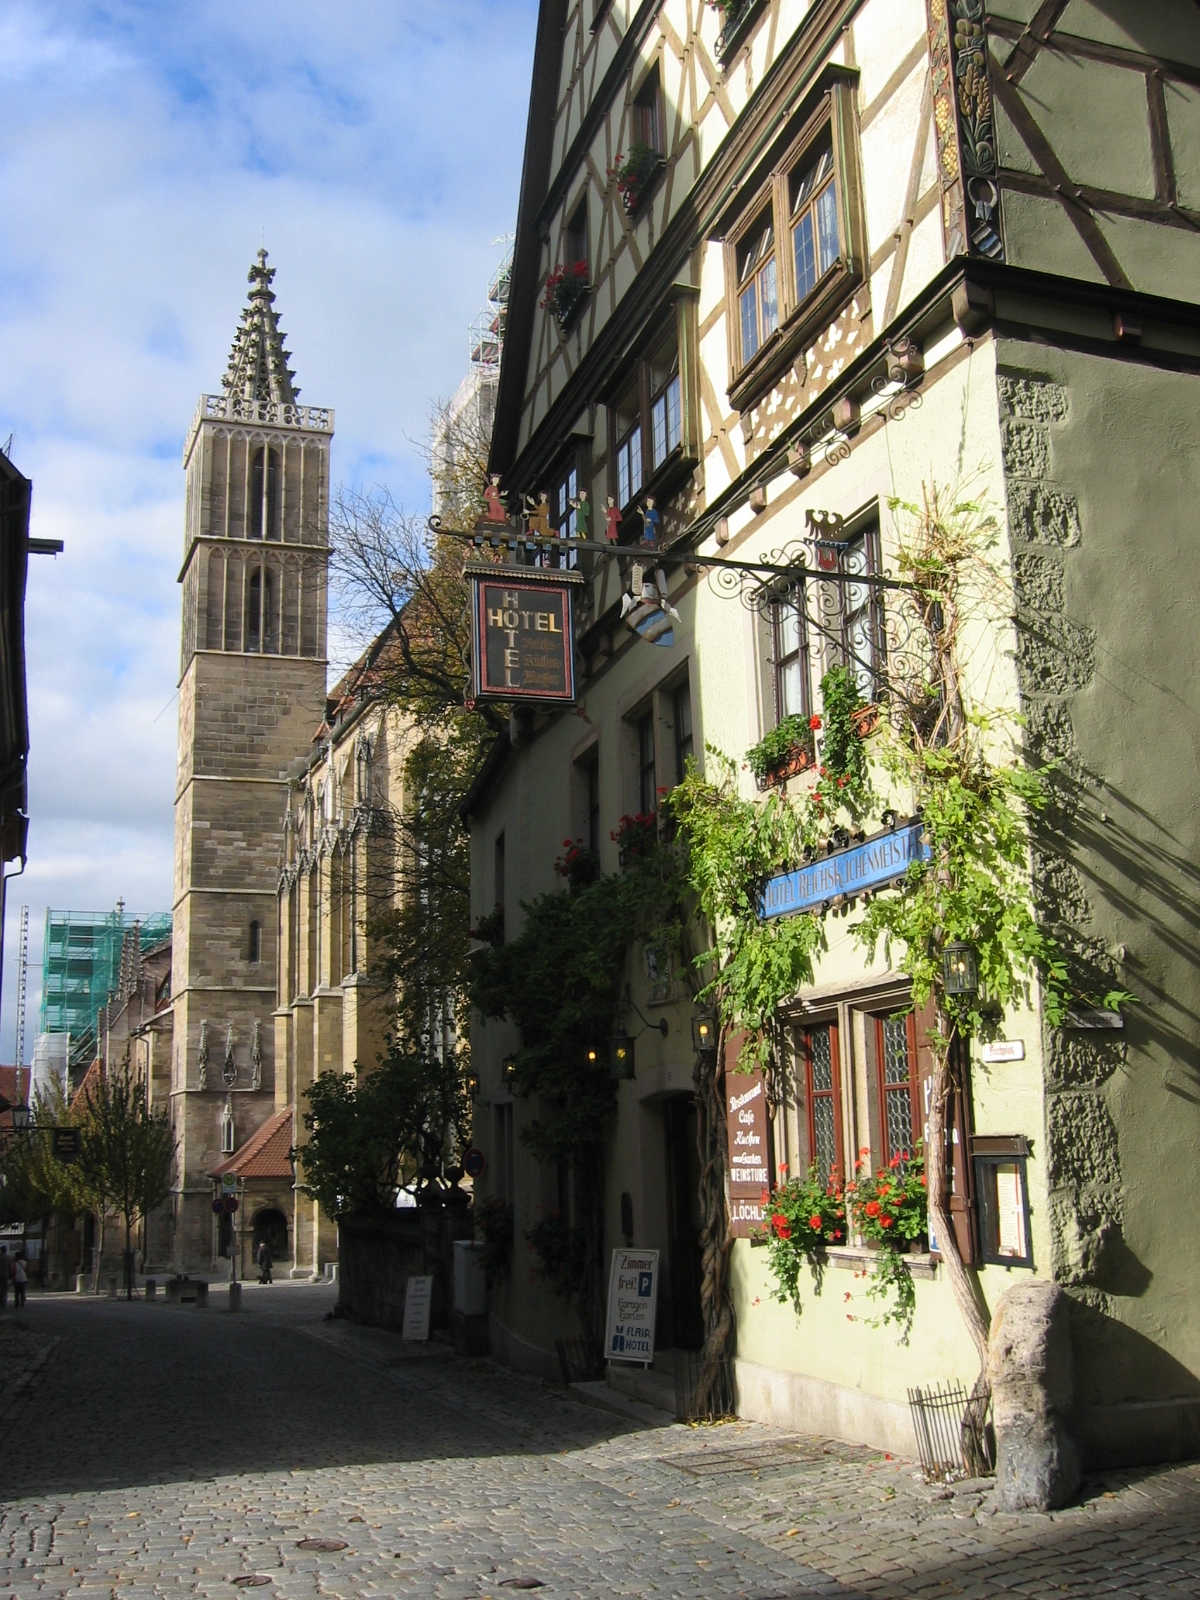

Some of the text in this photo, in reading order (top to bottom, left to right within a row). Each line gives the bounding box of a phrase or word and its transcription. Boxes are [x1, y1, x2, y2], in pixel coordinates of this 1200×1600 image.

[487, 608, 563, 633] HOTEL
[729, 1081, 762, 1113] Restaurant
[730, 1168, 768, 1182] WEINSTUBE
[620, 1255, 653, 1270] Zimmer
[618, 1275, 637, 1290] frei!
[617, 1298, 648, 1312] Garagen
[619, 1308, 644, 1321] Garten
[626, 1326, 651, 1338] FLAIR
[625, 1340, 651, 1352] HOTEL
